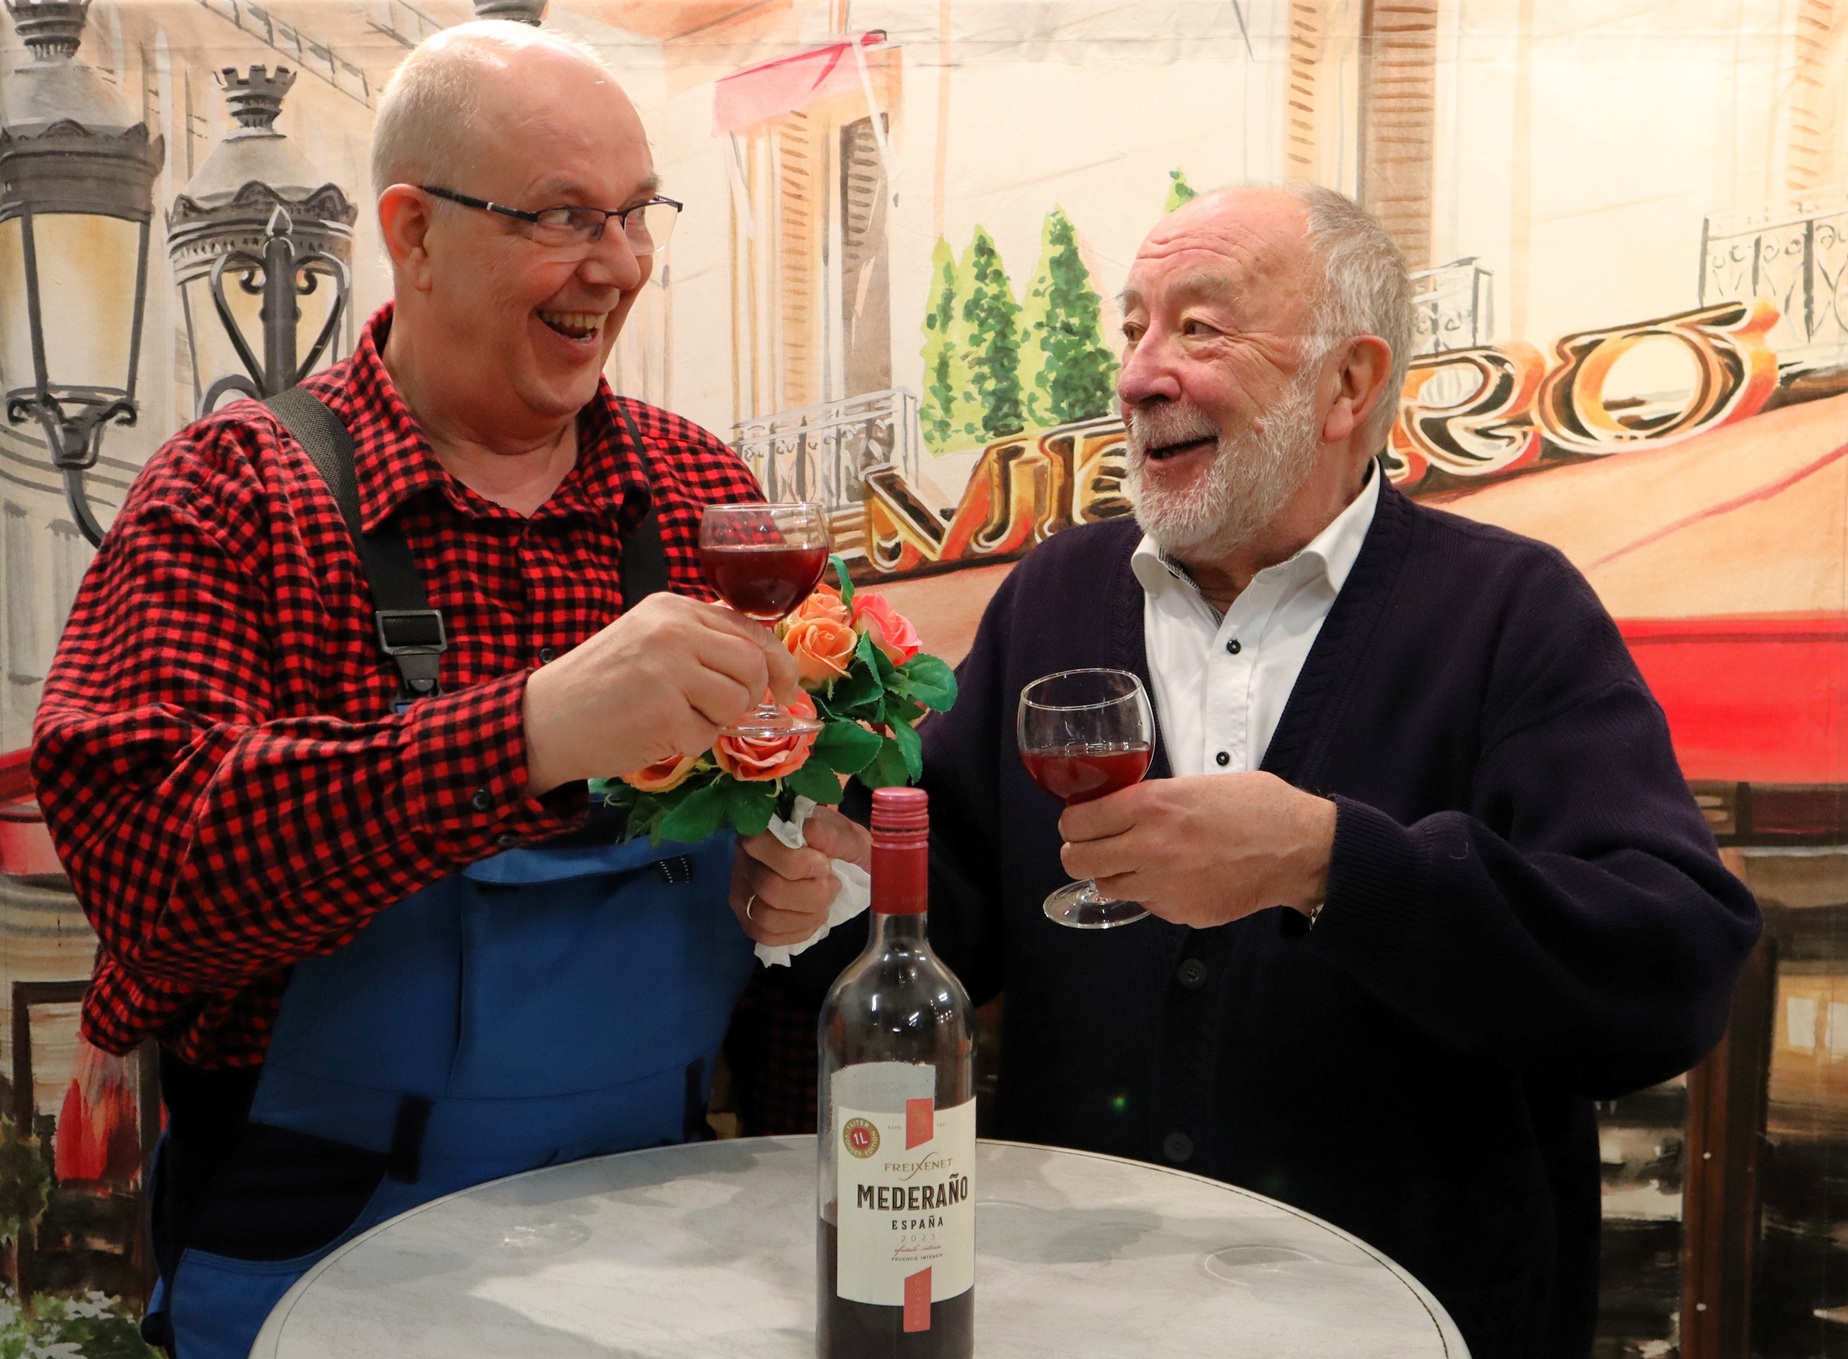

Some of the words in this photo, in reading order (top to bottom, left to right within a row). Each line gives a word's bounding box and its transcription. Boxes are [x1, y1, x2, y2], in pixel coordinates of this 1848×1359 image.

[853, 1132, 869, 1145] 1L
[884, 1153, 953, 1180] FREIXENET
[857, 1172, 968, 1211] MEDERAÑO
[891, 1215, 944, 1230] ESPAÑA
[901, 1233, 936, 1243] 2023
